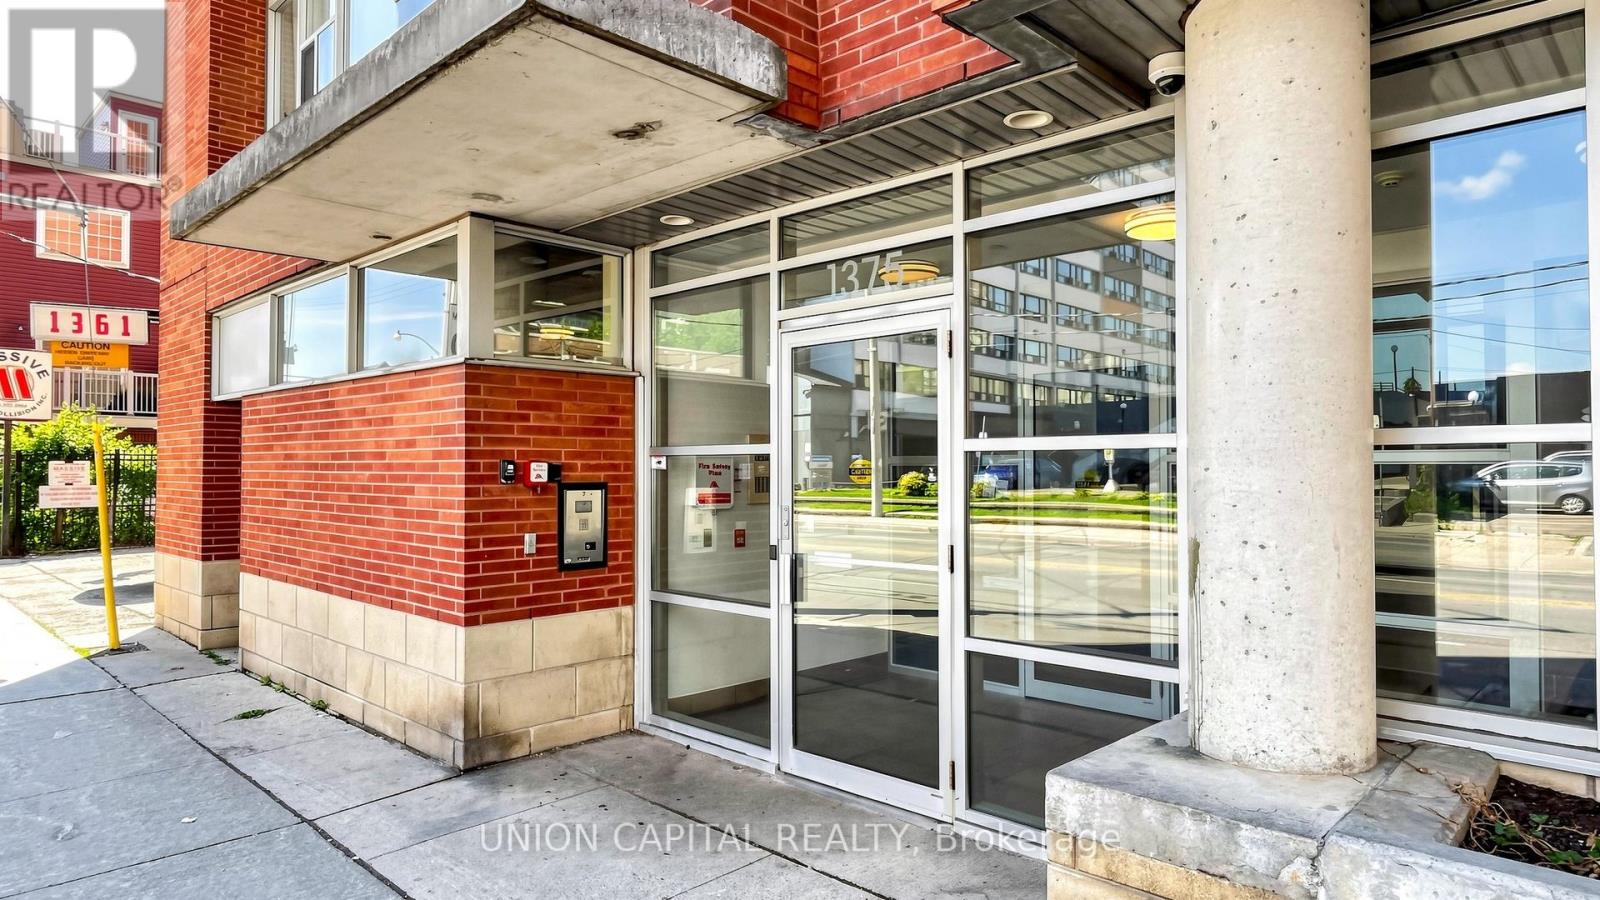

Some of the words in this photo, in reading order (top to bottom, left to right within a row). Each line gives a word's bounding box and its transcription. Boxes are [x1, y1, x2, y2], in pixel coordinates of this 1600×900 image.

[826, 250, 904, 297] 1375
[50, 311, 130, 336] 1361
[61, 341, 110, 351] CAUTION
